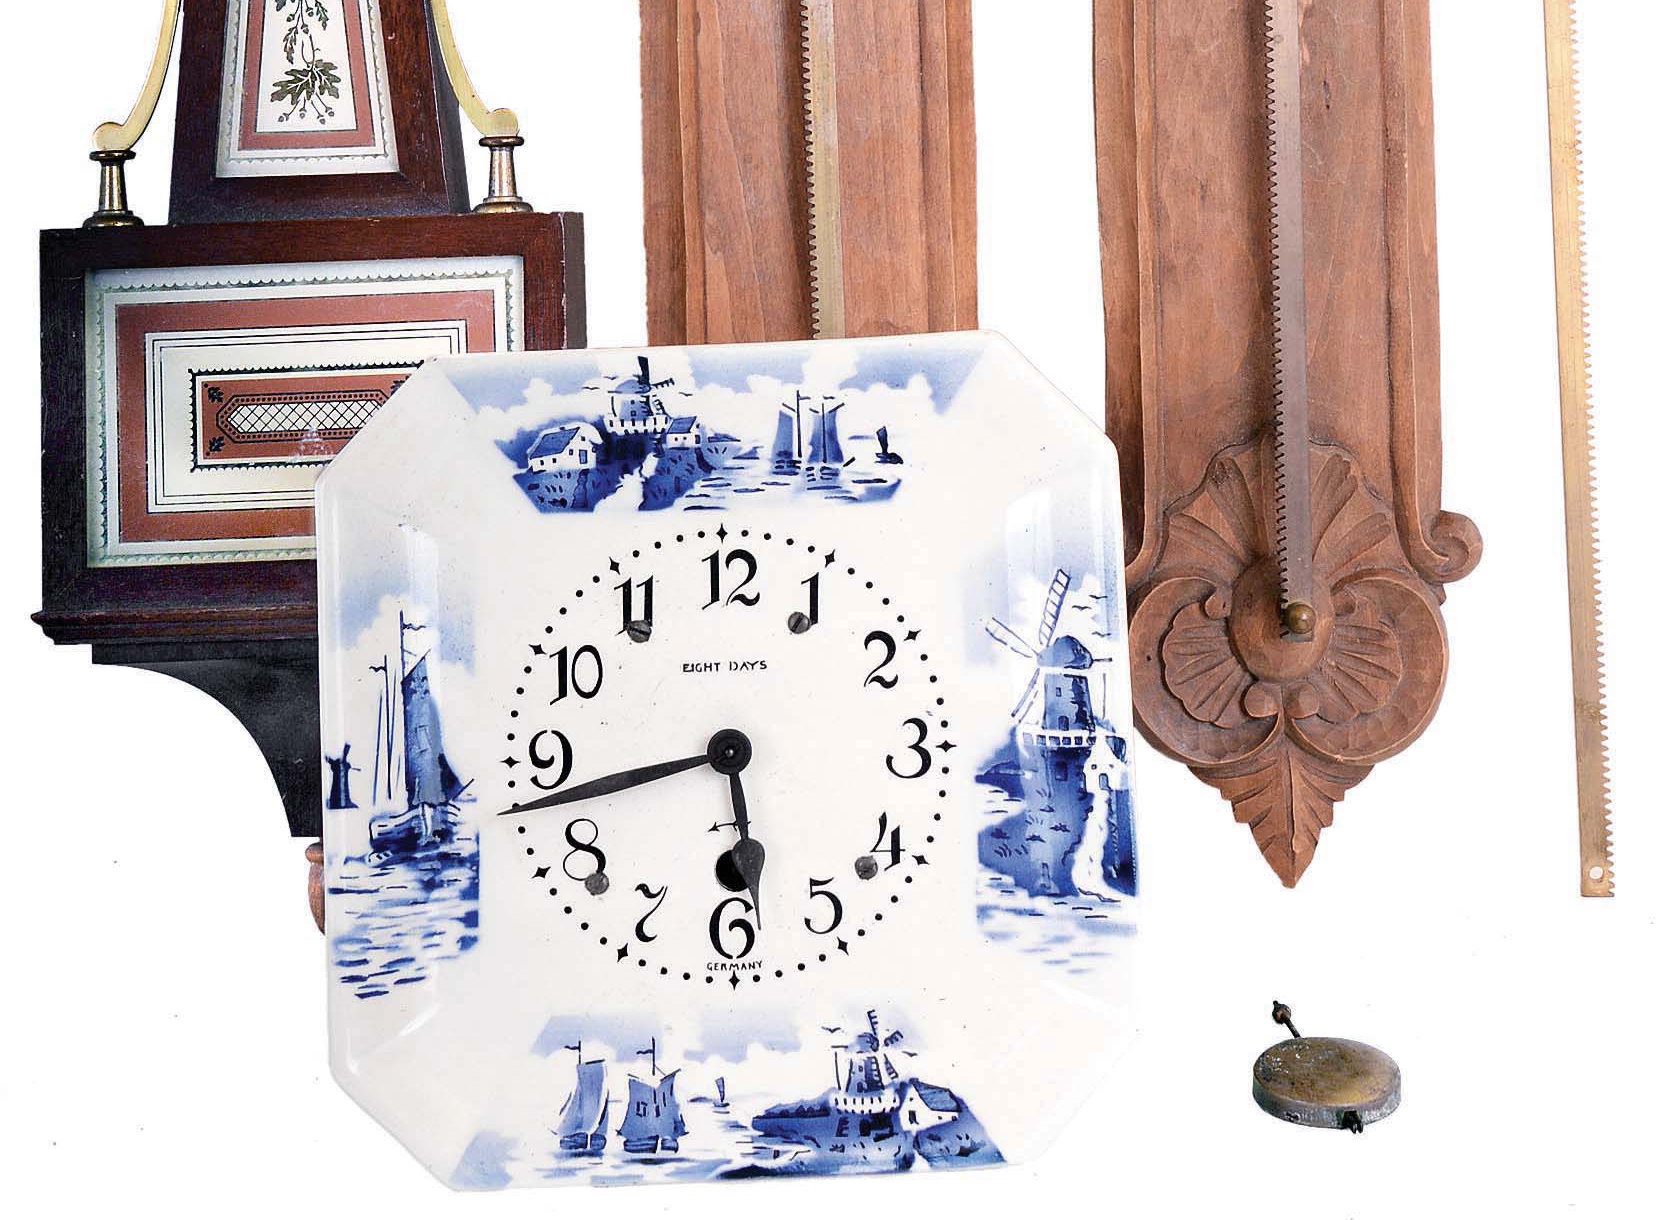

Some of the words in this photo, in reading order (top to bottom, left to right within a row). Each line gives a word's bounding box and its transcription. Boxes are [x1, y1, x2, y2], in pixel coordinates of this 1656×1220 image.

[614, 575, 654, 635] 11
[701, 549, 760, 610] 12
[800, 572, 819, 625] 1
[549, 644, 603, 705] 10
[682, 662, 720, 673] EIGHT
[729, 660, 767, 672] DAYS
[864, 630, 898, 688] 2
[528, 730, 573, 790] 9
[886, 717, 932, 778] 3
[562, 818, 606, 881] 8
[870, 812, 905, 871] 4
[634, 883, 667, 942] 7
[709, 897, 755, 959] 6
[804, 877, 843, 934] 5
[706, 960, 762, 972] GERMANY
